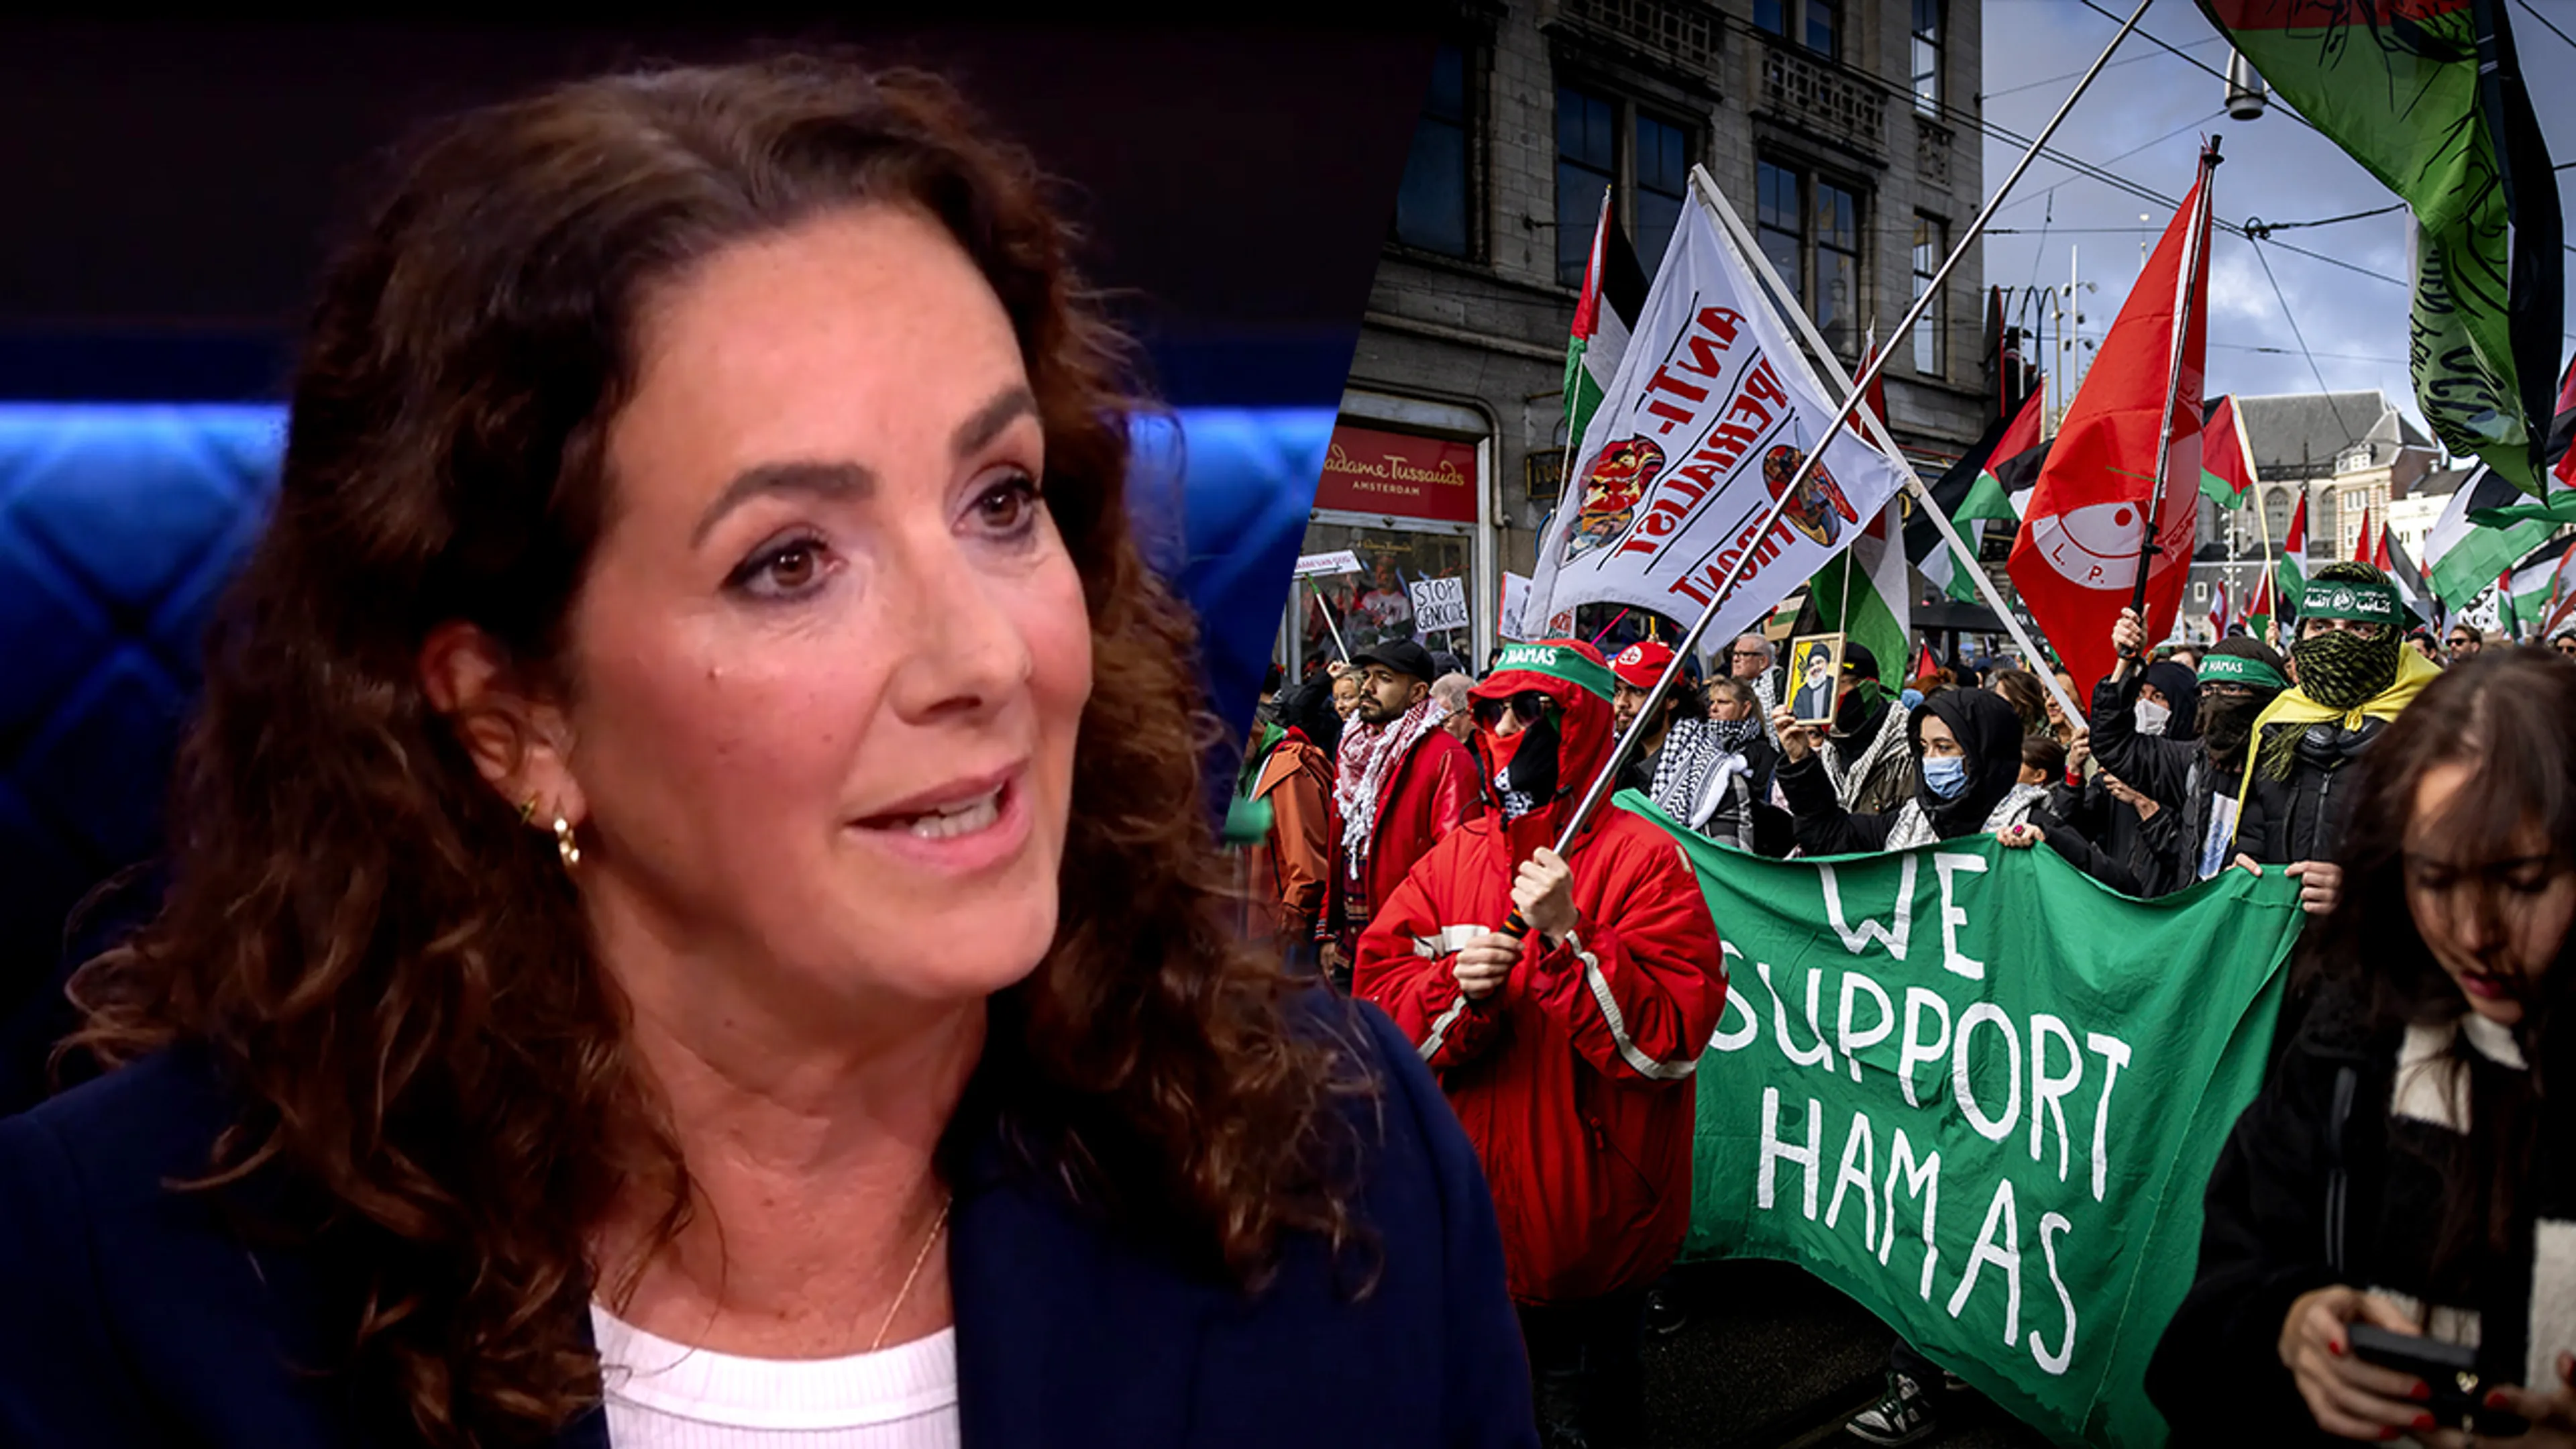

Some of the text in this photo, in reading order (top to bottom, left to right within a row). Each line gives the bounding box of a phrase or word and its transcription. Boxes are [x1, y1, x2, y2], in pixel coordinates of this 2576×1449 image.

[1324, 443, 1465, 486] adame Tussauds
[1352, 480, 1420, 496] AMSTERDAM
[1415, 580, 1456, 606] STOP
[1505, 647, 1557, 666] HAMAS
[2208, 660, 2243, 674] HAMAS
[1819, 852, 1988, 980] WE
[1707, 939, 2133, 1202] SUPPORT
[1757, 1087, 2077, 1375] HAMAS
